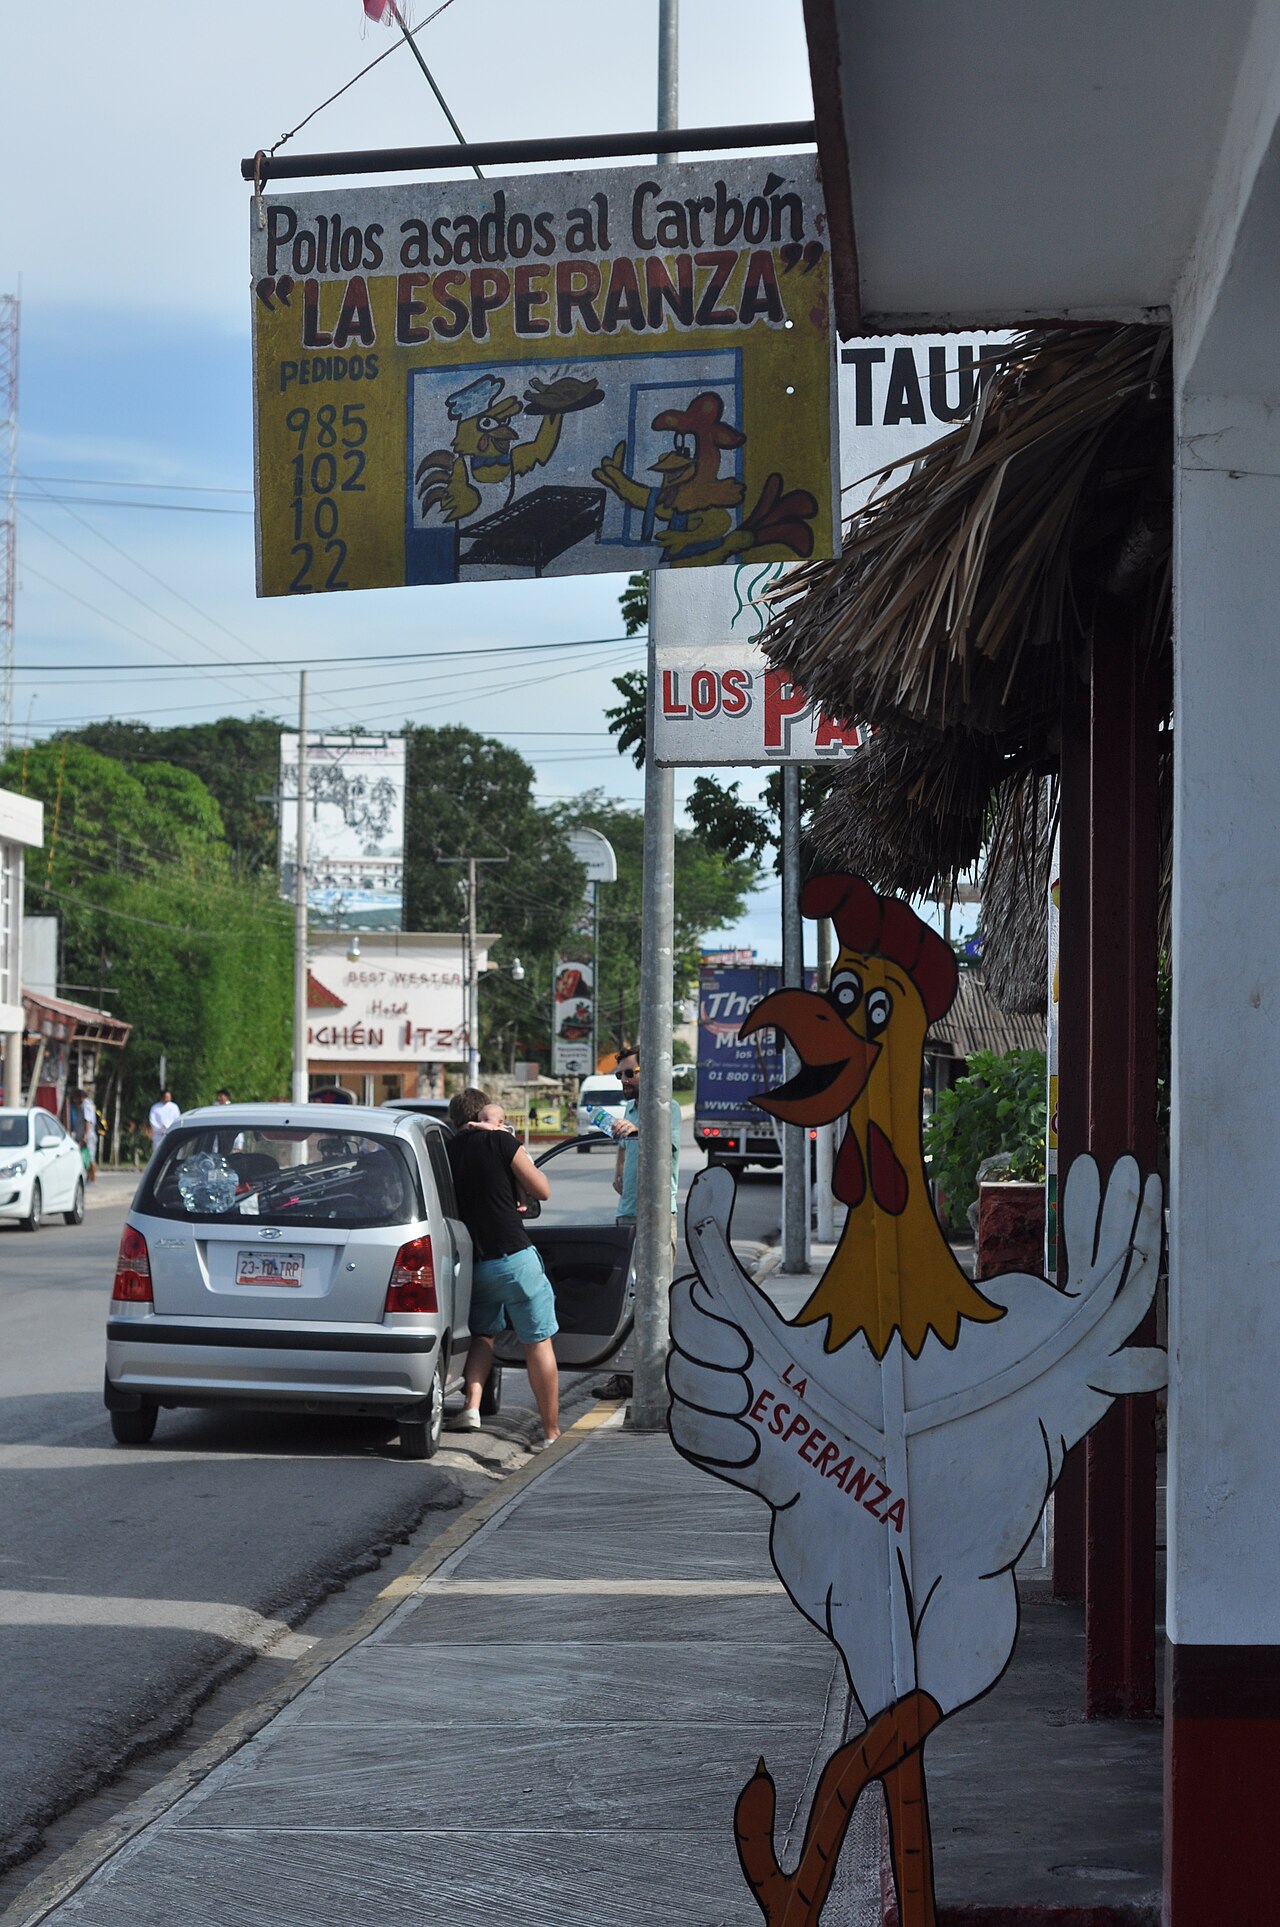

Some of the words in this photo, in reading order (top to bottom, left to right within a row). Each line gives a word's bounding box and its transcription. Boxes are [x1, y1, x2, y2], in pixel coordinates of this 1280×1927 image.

[266, 205, 384, 276] Pollos
[400, 189, 556, 268] asados
[566, 192, 612, 252] al
[632, 172, 804, 250] Carbón
[279, 354, 380, 392] PEDIDOS
[286, 403, 368, 451] 985
[290, 450, 366, 497] 102
[289, 497, 339, 541] 10
[289, 539, 349, 592] 22
[662, 669, 750, 718] LOS
[763, 668, 882, 750] PA
[349, 972, 387, 984] BEST
[395, 972, 466, 985] WESTER
[371, 1000, 408, 1015] Hotel
[708, 1071, 722, 1081] 01
[726, 1071, 749, 1082] 800
[781, 1363, 808, 1399] LA
[749, 1389, 906, 1534] ESPERANZA
